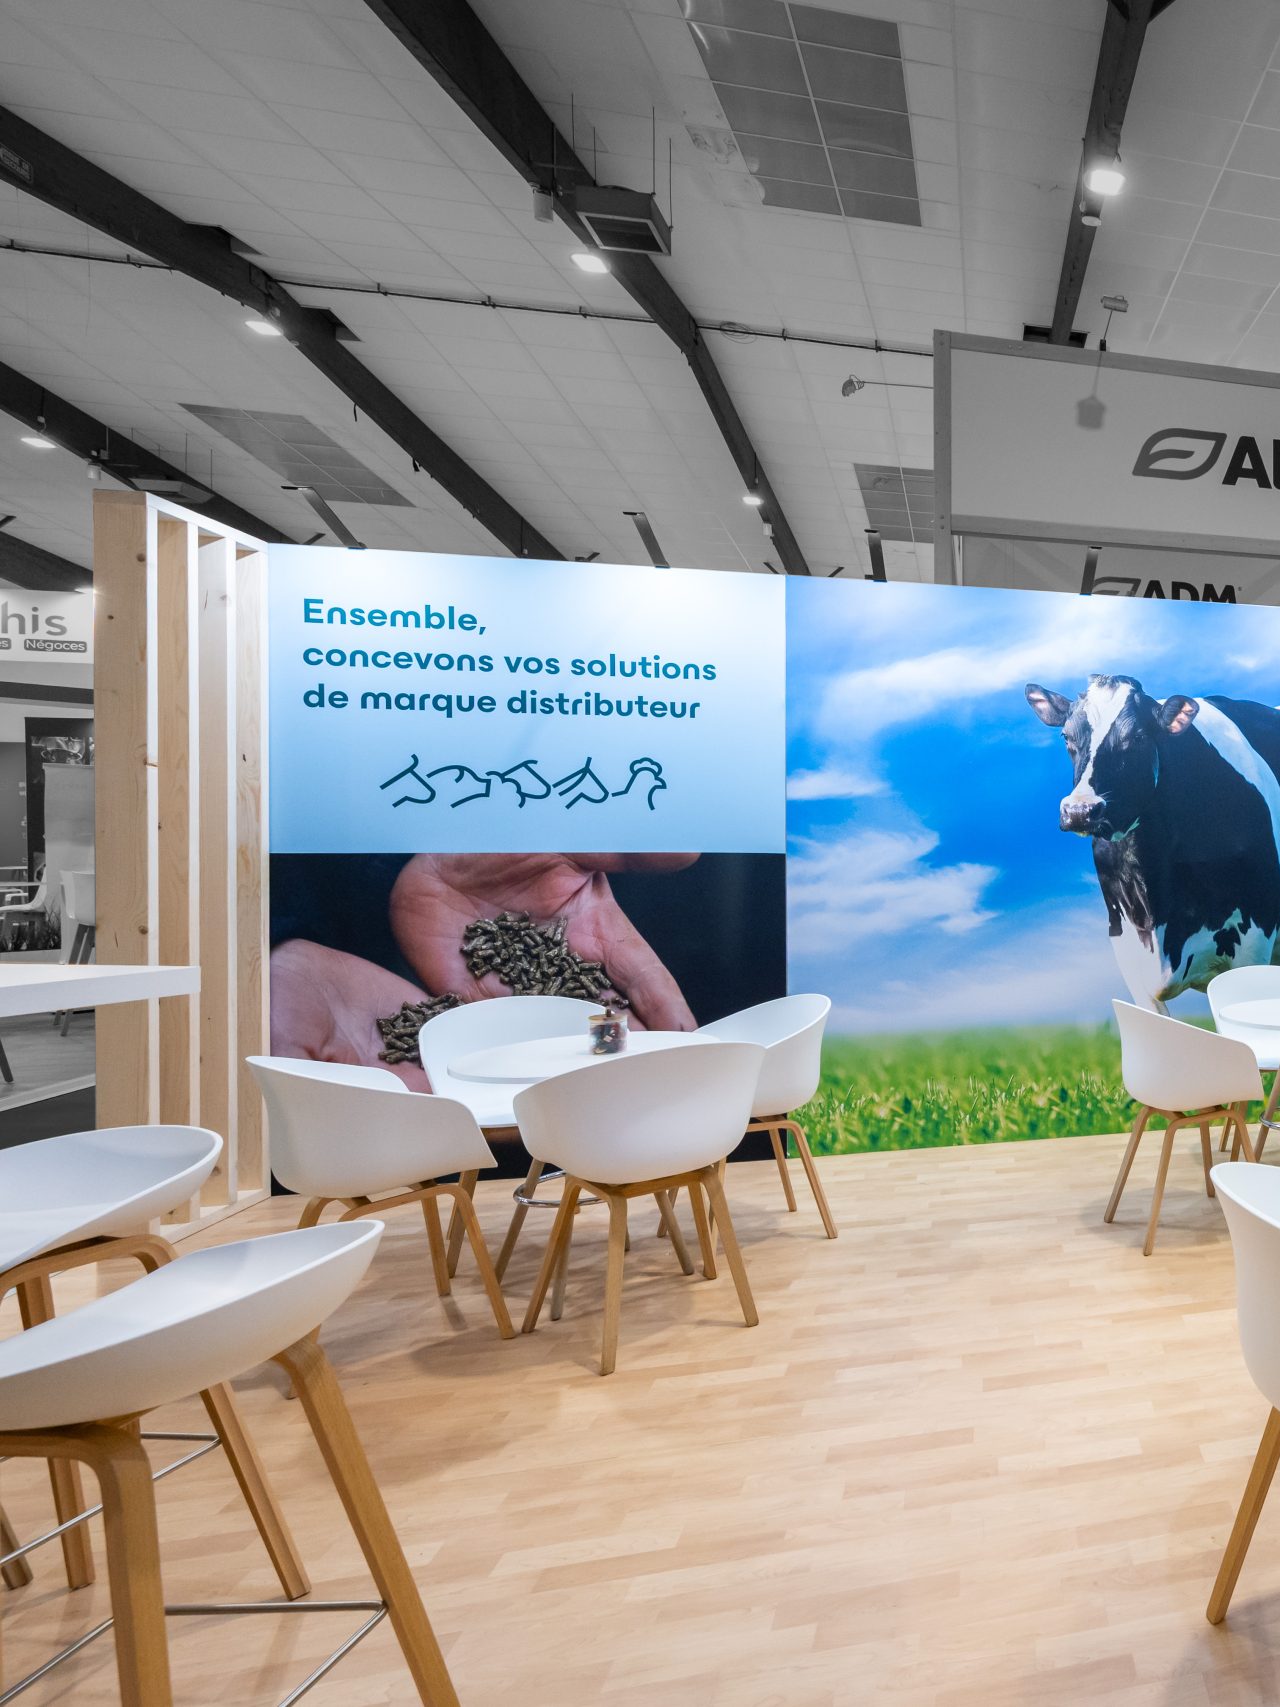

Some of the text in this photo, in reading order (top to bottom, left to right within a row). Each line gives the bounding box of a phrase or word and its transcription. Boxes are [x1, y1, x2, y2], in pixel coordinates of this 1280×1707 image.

[303, 597, 487, 635] Ensemble,
[26, 639, 86, 652] Négoces
[303, 647, 717, 681] concevons vos solutions
[303, 683, 701, 719] de marque distributeur
